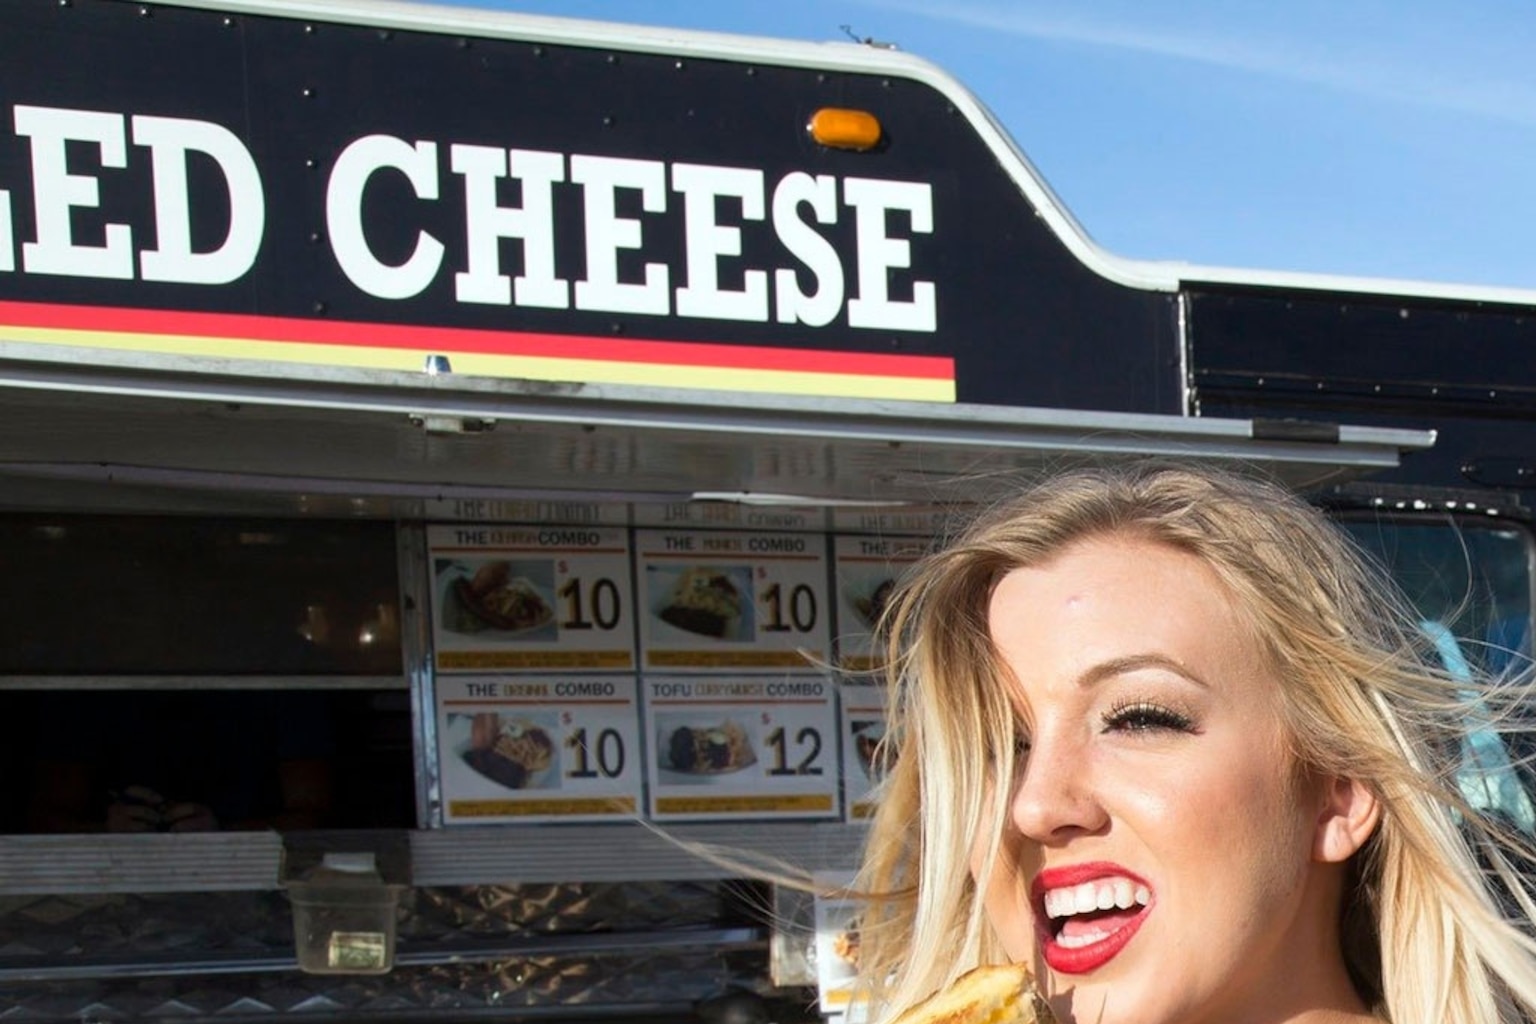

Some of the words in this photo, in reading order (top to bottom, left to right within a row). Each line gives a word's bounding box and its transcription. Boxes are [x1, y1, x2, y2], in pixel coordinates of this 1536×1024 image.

[0, 104, 265, 285] ED
[326, 134, 937, 332] CHEESE
[455, 530, 488, 545] THE
[538, 531, 600, 546] COMBO
[664, 536, 694, 551] THE
[747, 537, 805, 552] COMBO
[466, 683, 497, 697] THE
[554, 682, 615, 697] COMBO
[652, 683, 691, 697] TOFU
[766, 683, 824, 697] COMBO
